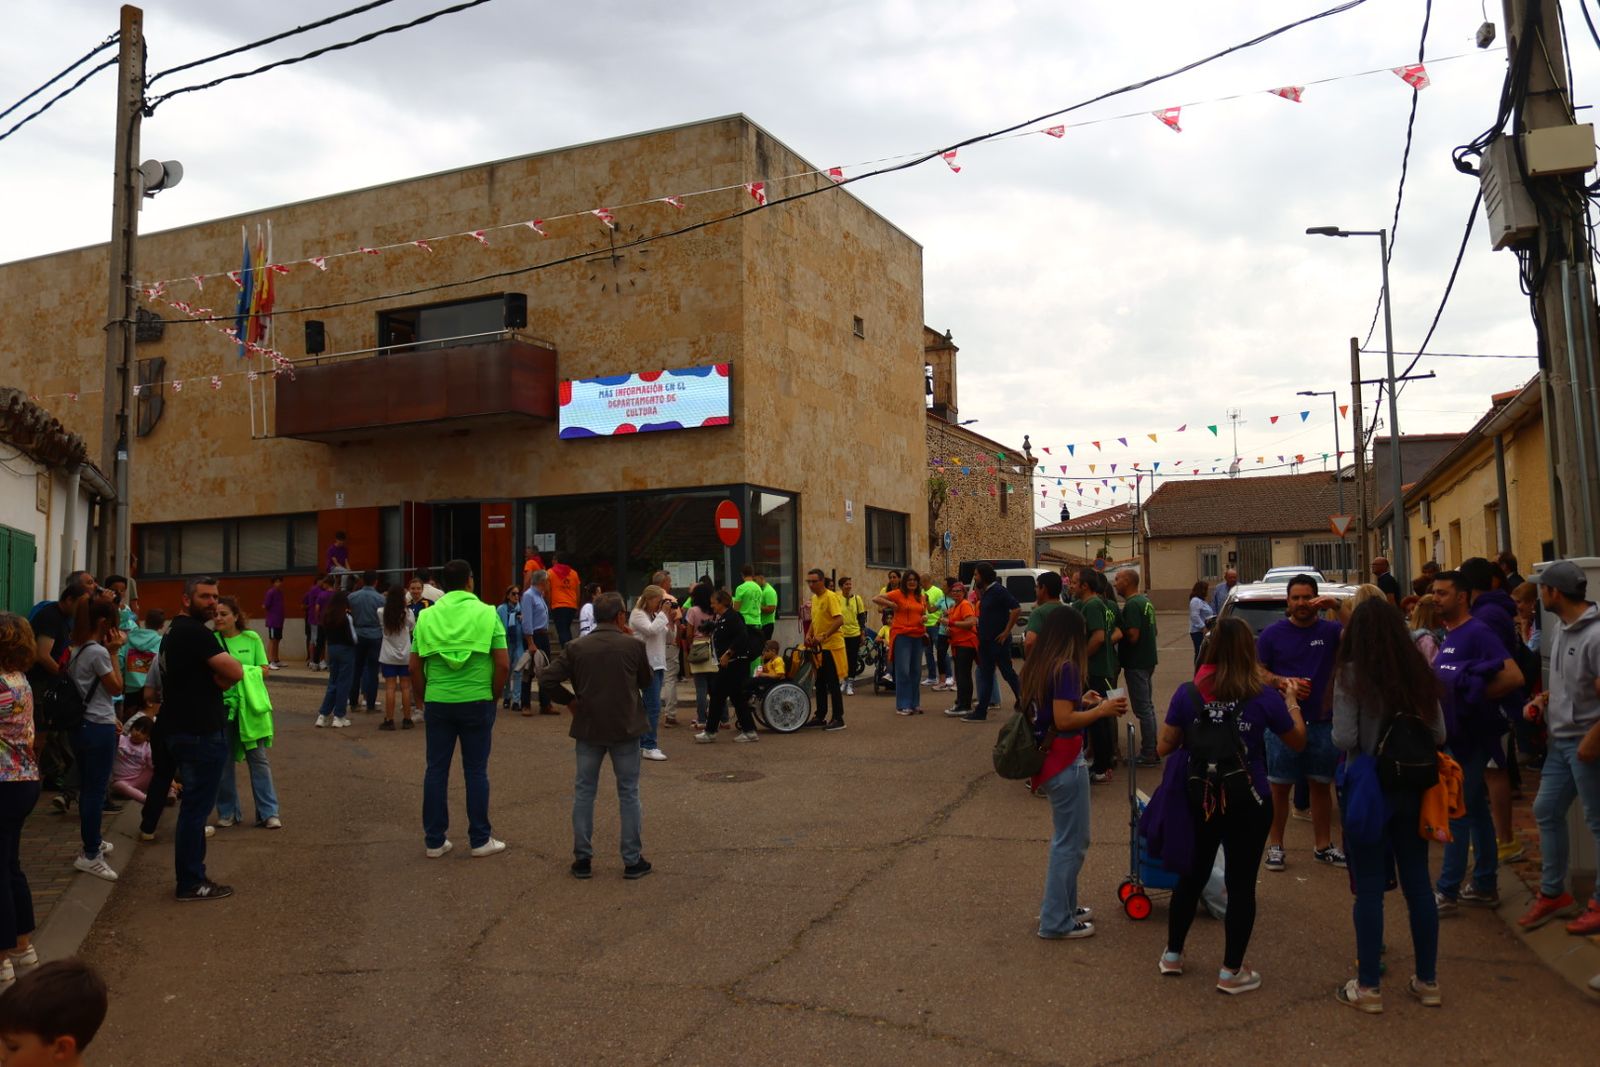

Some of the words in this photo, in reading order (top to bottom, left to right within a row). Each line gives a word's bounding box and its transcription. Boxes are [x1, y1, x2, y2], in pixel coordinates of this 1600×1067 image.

[599, 389, 613, 399] MÁS
[615, 383, 663, 396] INFORMACIÓN
[665, 383, 675, 391] EN
[677, 382, 686, 391] EL
[608, 395, 665, 408] DEPARTAMENTO
[666, 394, 677, 402] DE
[625, 407, 657, 417] CULTURA
